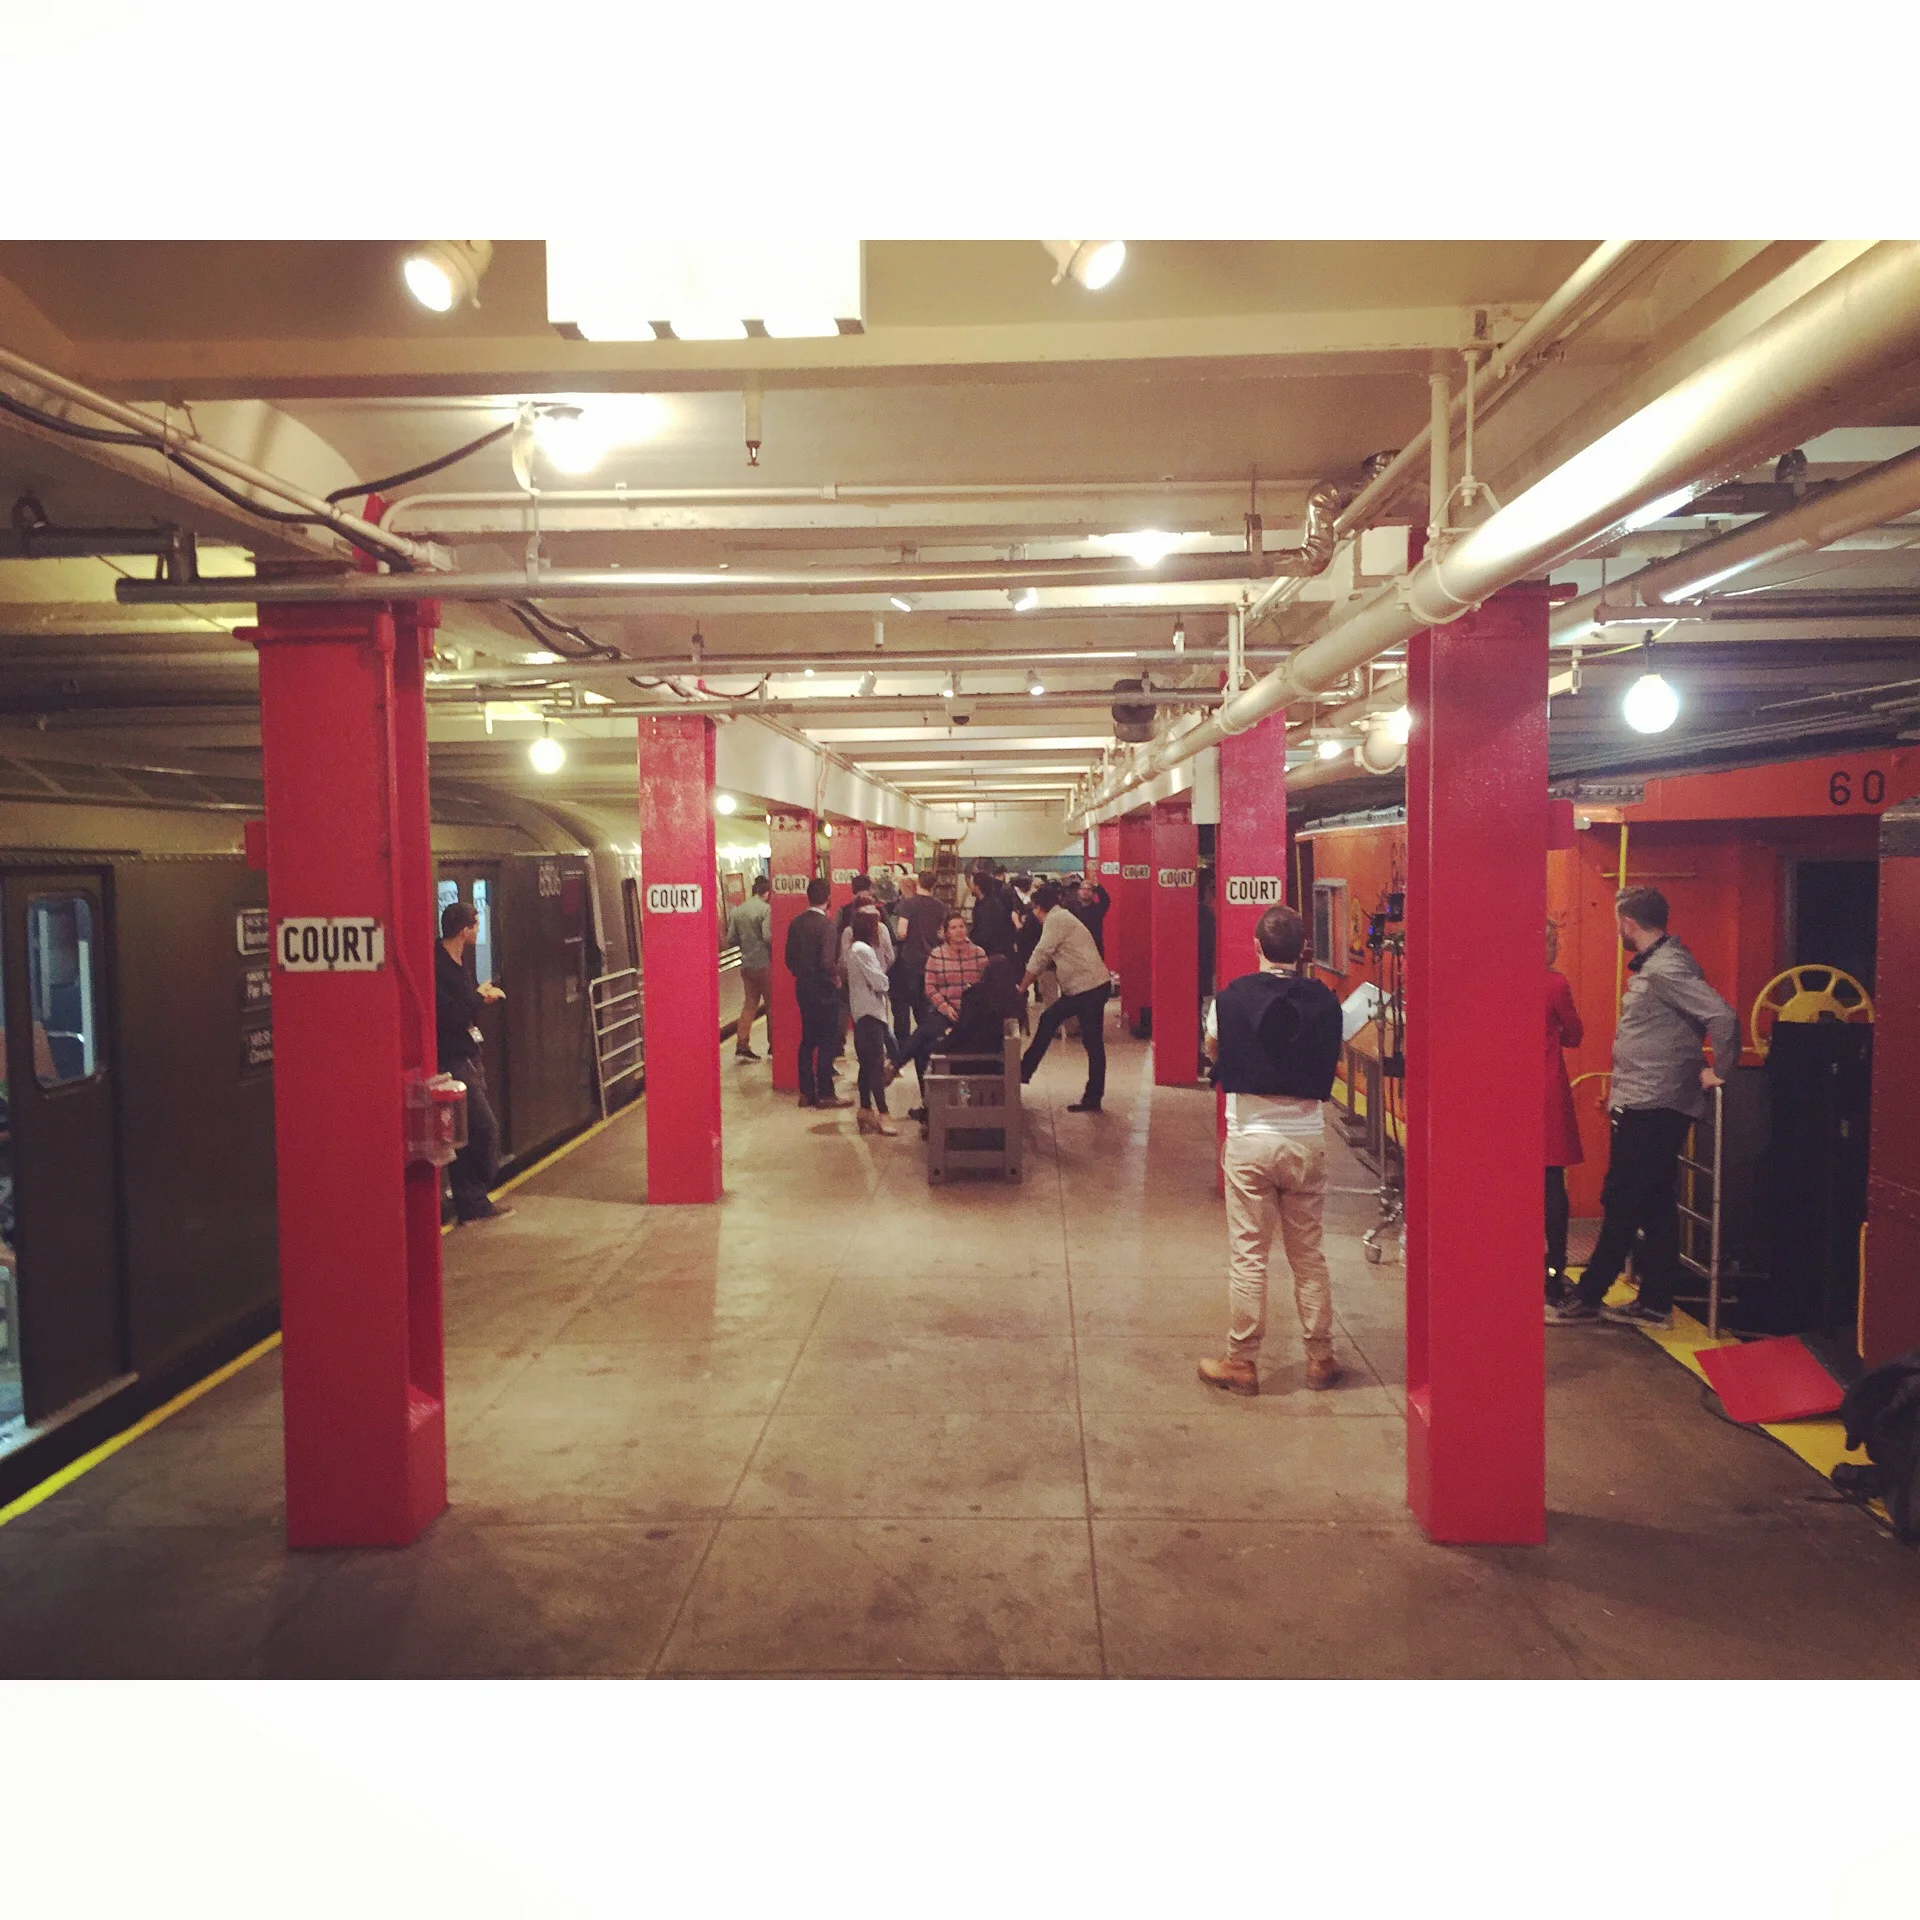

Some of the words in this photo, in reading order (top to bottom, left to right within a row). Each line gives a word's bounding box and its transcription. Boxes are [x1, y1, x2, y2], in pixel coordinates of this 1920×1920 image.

[1829, 768, 1888, 807] 60
[1124, 866, 1148, 878] COURT
[1160, 869, 1192, 885] COURT
[774, 877, 806, 893] COURT
[1229, 880, 1278, 901] COURT
[650, 889, 699, 910] COURT
[283, 926, 378, 965] COURT
